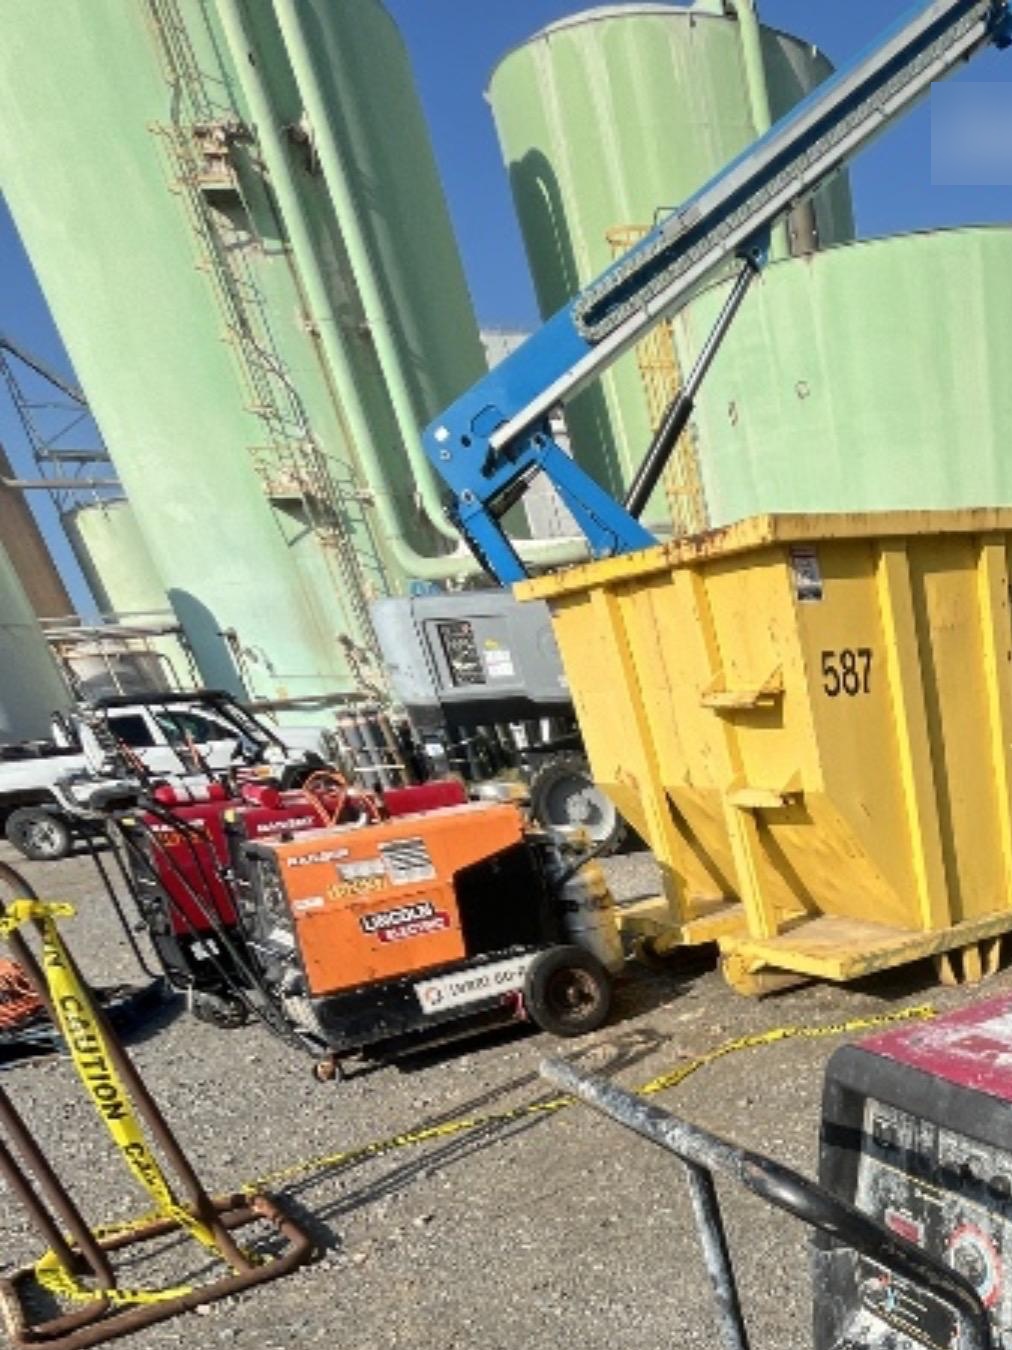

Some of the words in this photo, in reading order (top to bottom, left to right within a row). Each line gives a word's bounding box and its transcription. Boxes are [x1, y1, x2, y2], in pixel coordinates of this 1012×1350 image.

[820, 647, 874, 698] 587
[362, 901, 434, 932] LINCOLN
[58, 994, 128, 1122] CAUTION
